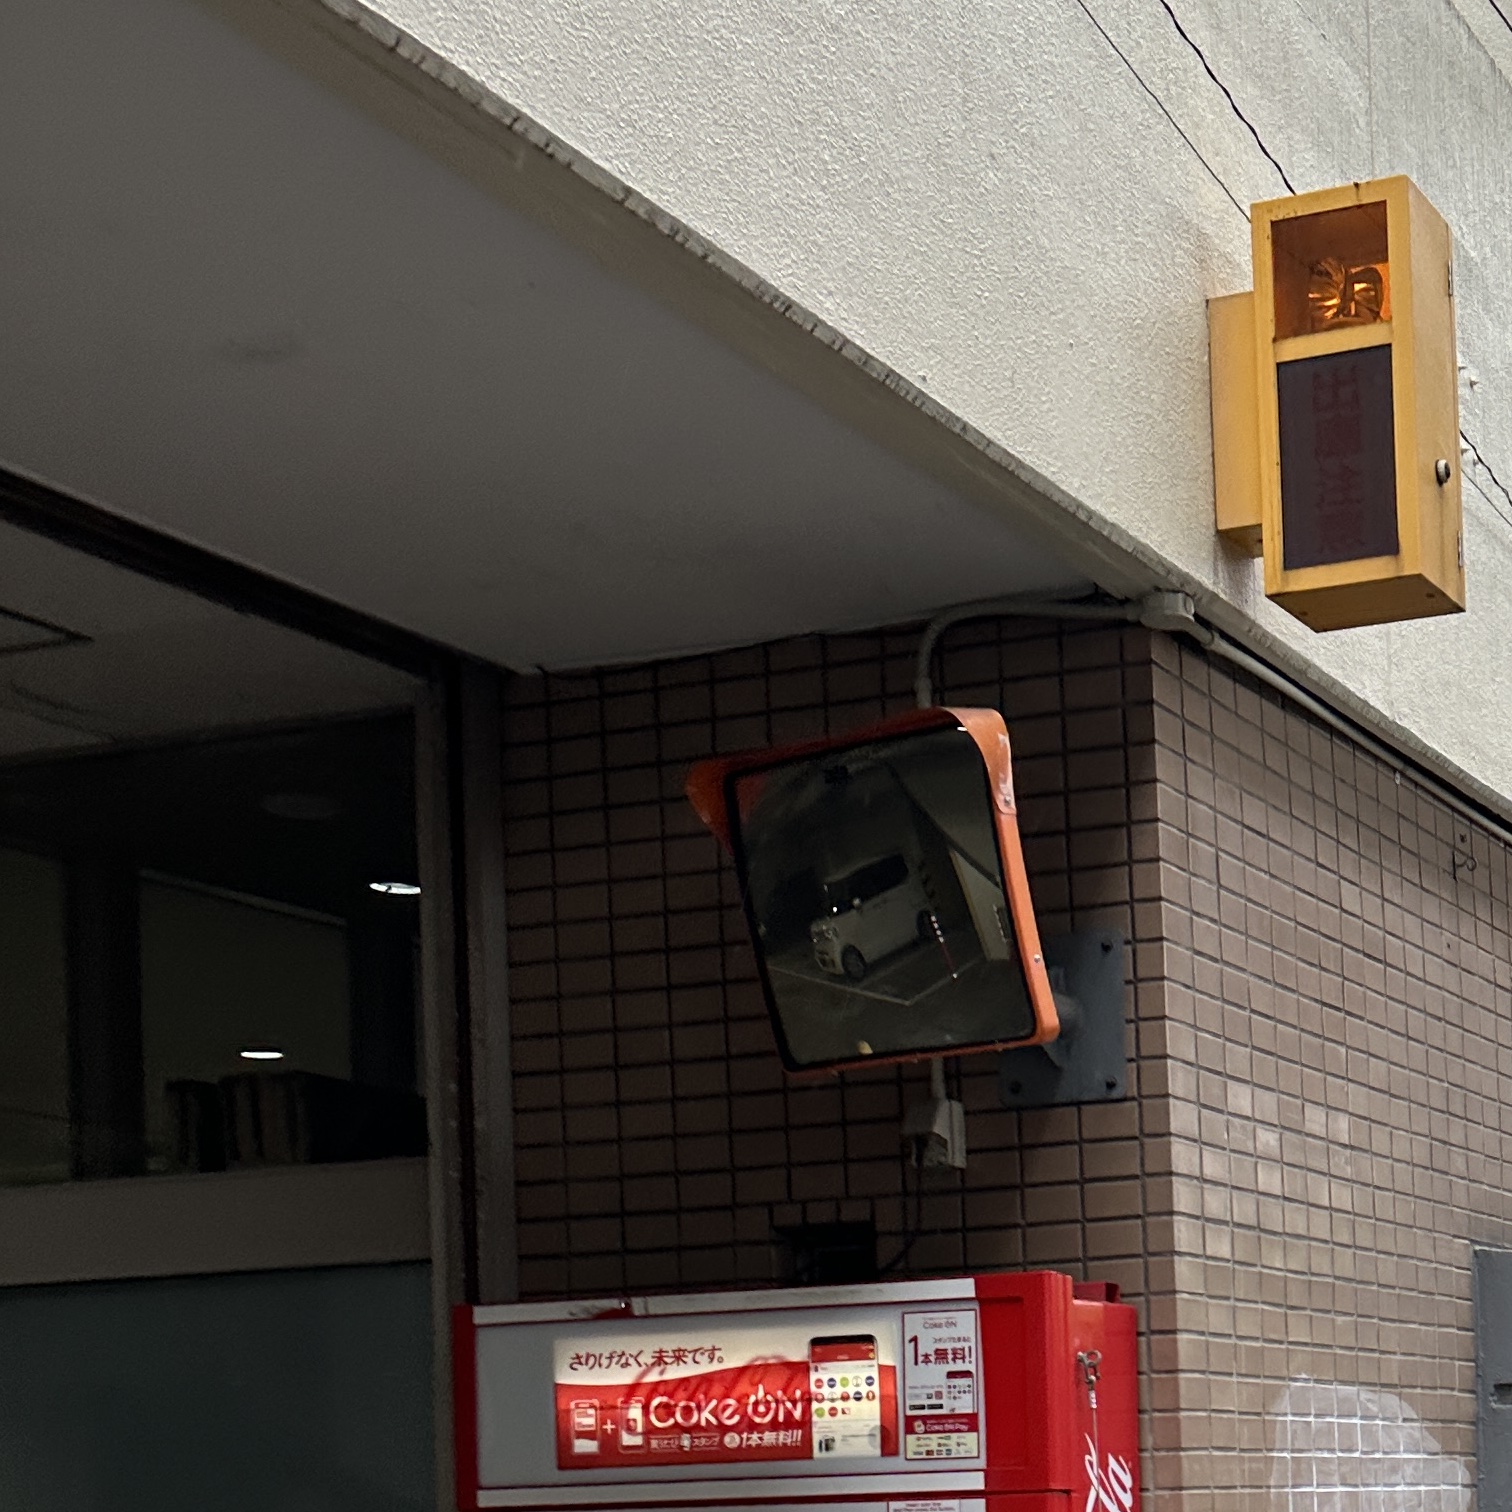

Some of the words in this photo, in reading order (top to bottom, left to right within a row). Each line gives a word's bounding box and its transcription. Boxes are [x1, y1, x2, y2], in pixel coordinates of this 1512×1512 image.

[569, 1345, 724, 1371] さりげなく、未来です。
[650, 1396, 741, 1428] Coke
[747, 1384, 803, 1424] ON
